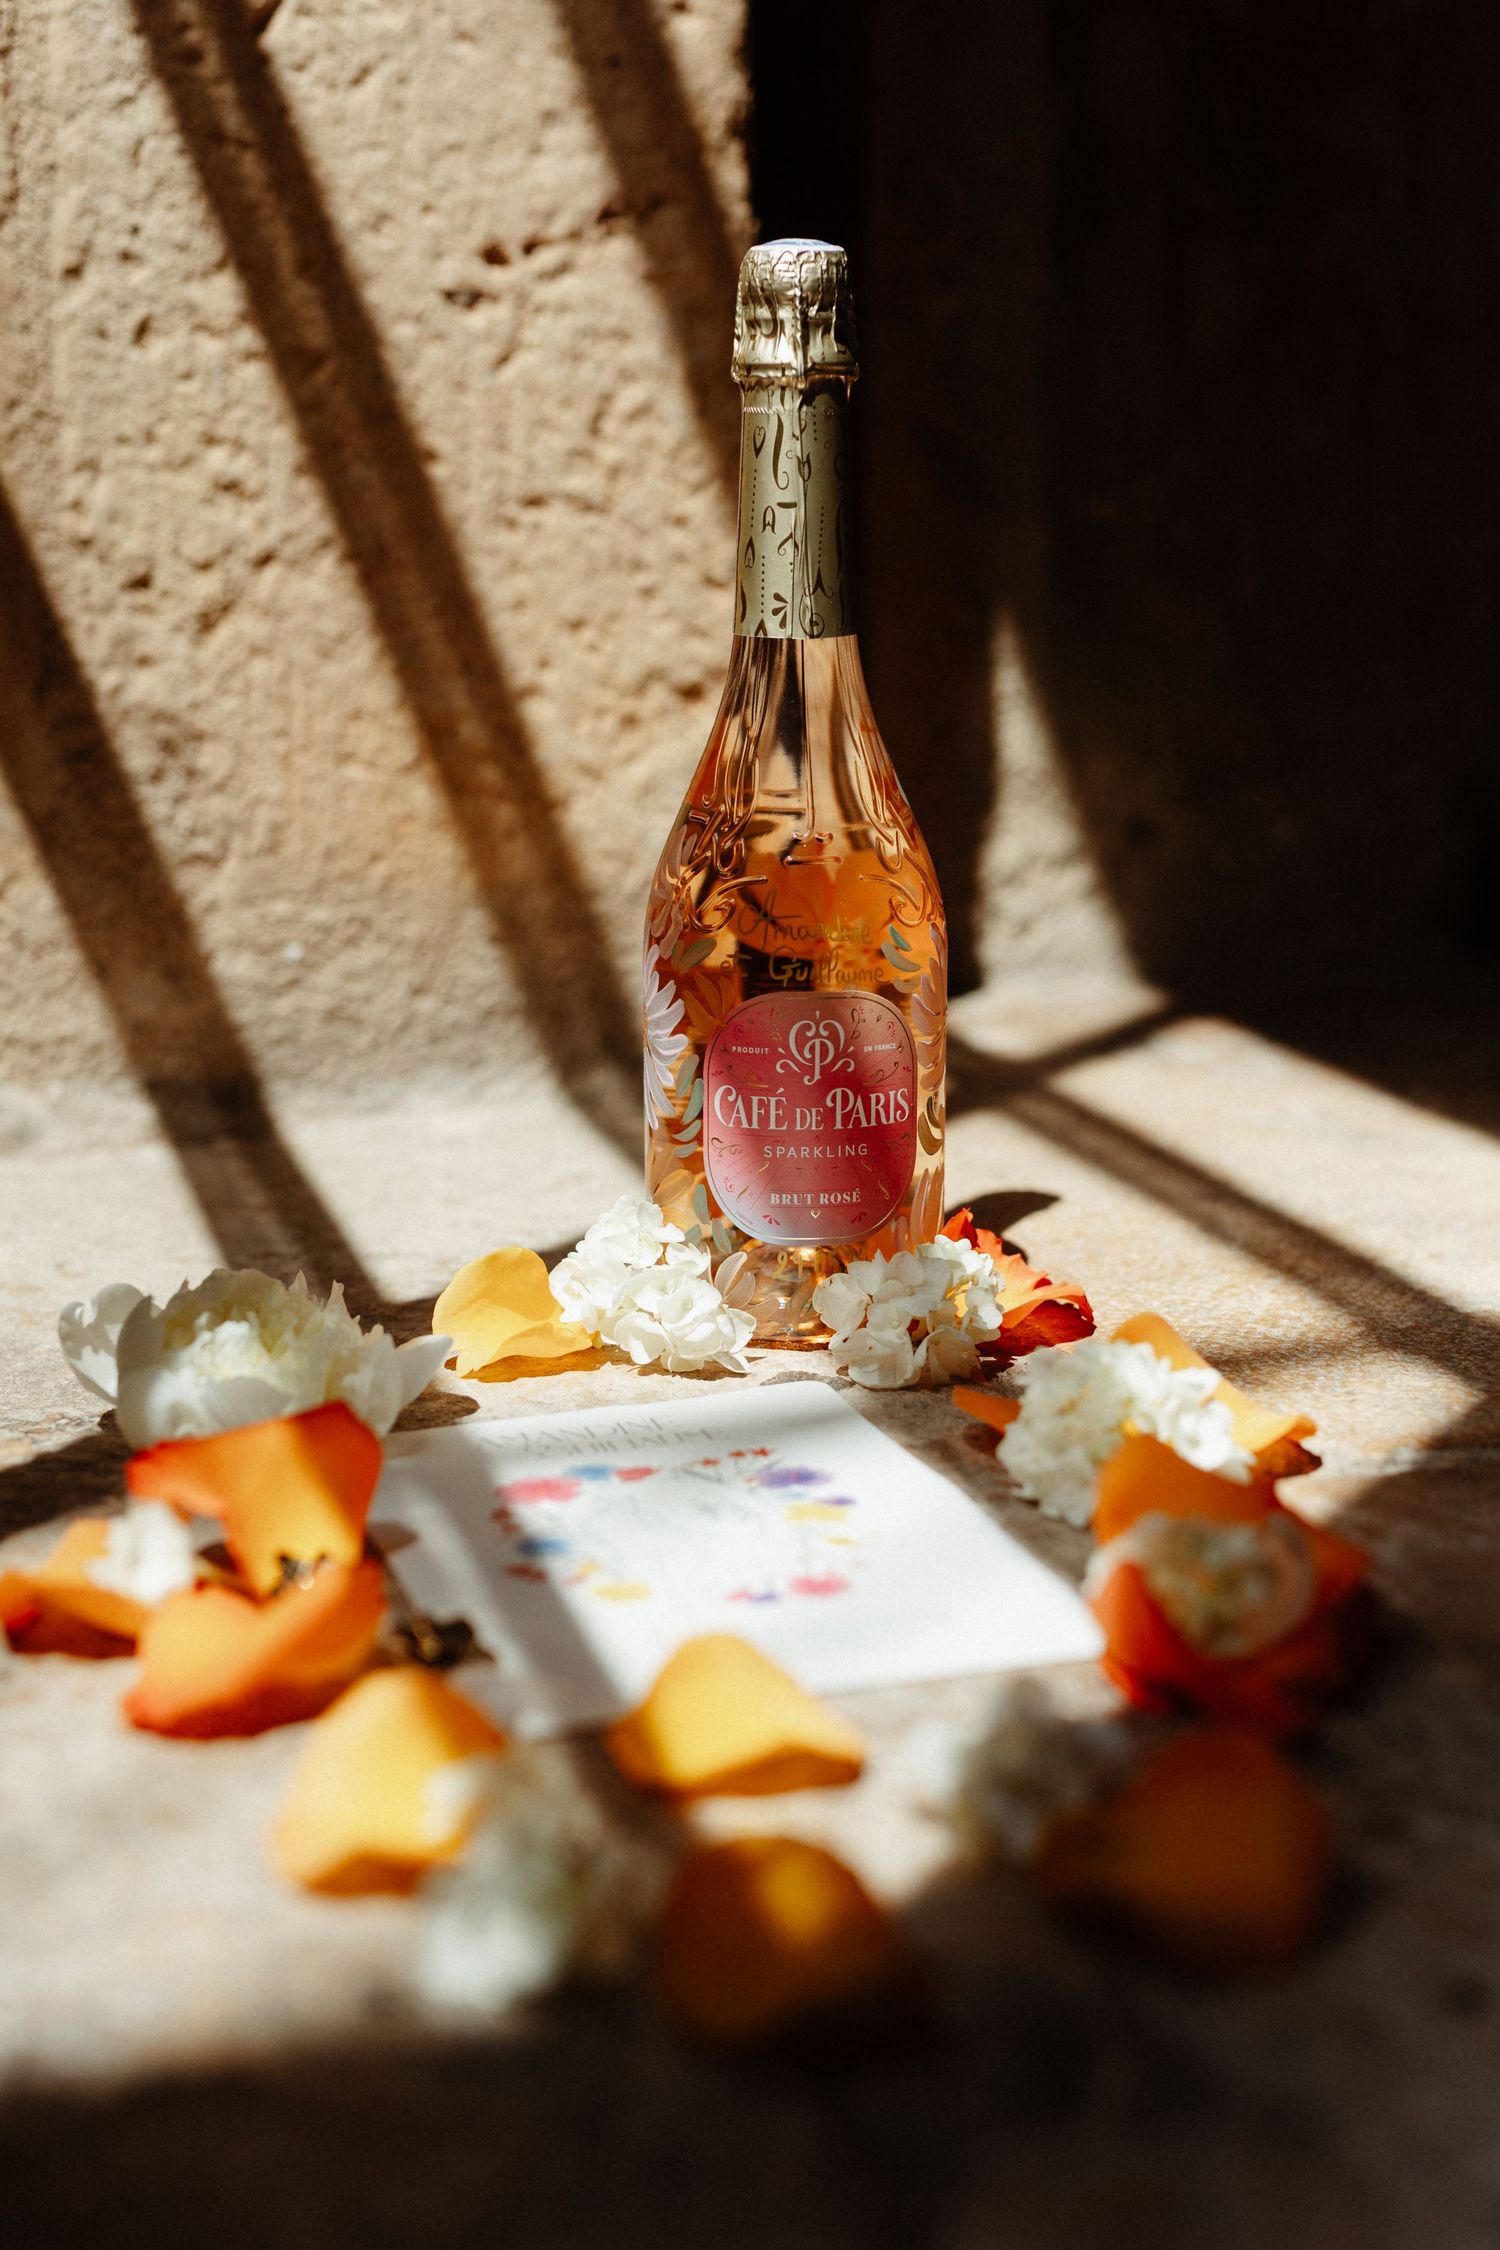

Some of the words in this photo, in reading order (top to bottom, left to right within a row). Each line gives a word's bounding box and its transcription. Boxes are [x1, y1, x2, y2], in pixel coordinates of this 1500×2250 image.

[731, 1046, 769, 1055] PRODUIT
[863, 1045, 874, 1053] EN
[874, 1043, 897, 1052] FRANCE
[763, 1144, 868, 1158] SPARKLING
[770, 1193, 815, 1205] BRUT
[819, 1187, 861, 1205] ROSÉ
